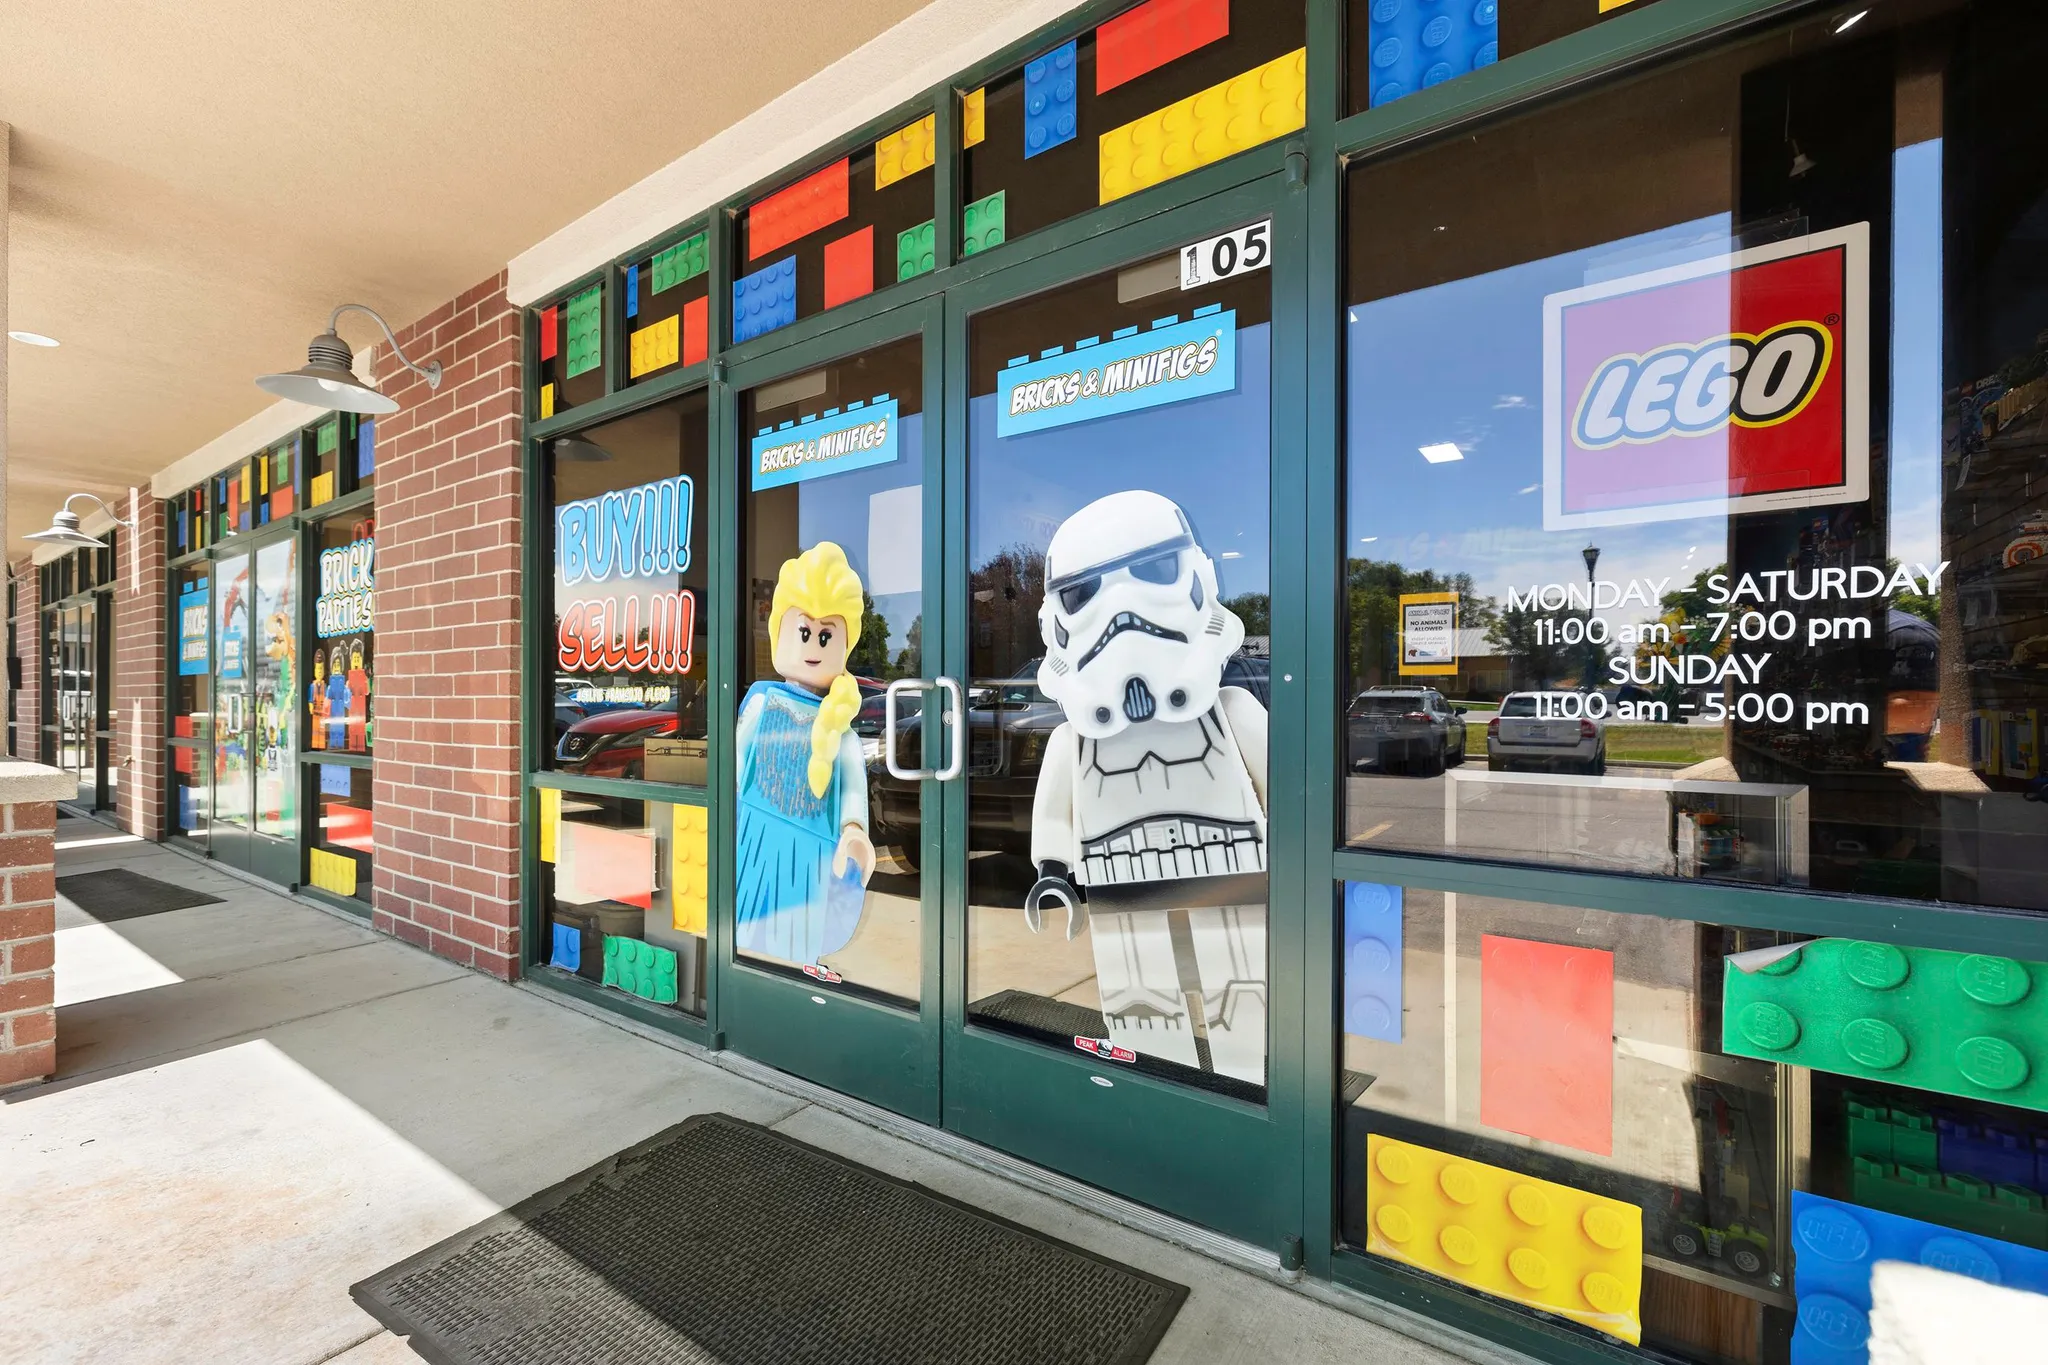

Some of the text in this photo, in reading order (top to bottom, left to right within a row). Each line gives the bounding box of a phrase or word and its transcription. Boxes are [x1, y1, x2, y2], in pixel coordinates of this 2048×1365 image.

[1185, 225, 1267, 286] 105
[1009, 337, 1218, 416] BRICKS & MINIFIGS
[1575, 324, 1828, 446] LEGO
[760, 419, 888, 474] BRICKS & MINIFIGS
[559, 475, 694, 585] BUY!!!
[320, 538, 374, 598] BRICK
[1507, 577, 1671, 613] MONDAY
[1706, 561, 1951, 604] SATURDAY
[317, 590, 374, 636] PARTIES
[559, 590, 695, 674] SELL!!!
[1533, 617, 1609, 645] 11:00
[1618, 622, 1669, 643] am
[1706, 610, 1796, 642] 7:00
[1808, 616, 1872, 647] pm
[1608, 653, 1773, 685] SUNDAY
[1532, 692, 1608, 720] 11:00
[1616, 700, 1669, 721] am
[1704, 692, 1795, 723] 5:00
[1806, 700, 1870, 731] pm
[1079, 1039, 1094, 1050] PEAK
[1113, 1049, 1133, 1061] ALARM
